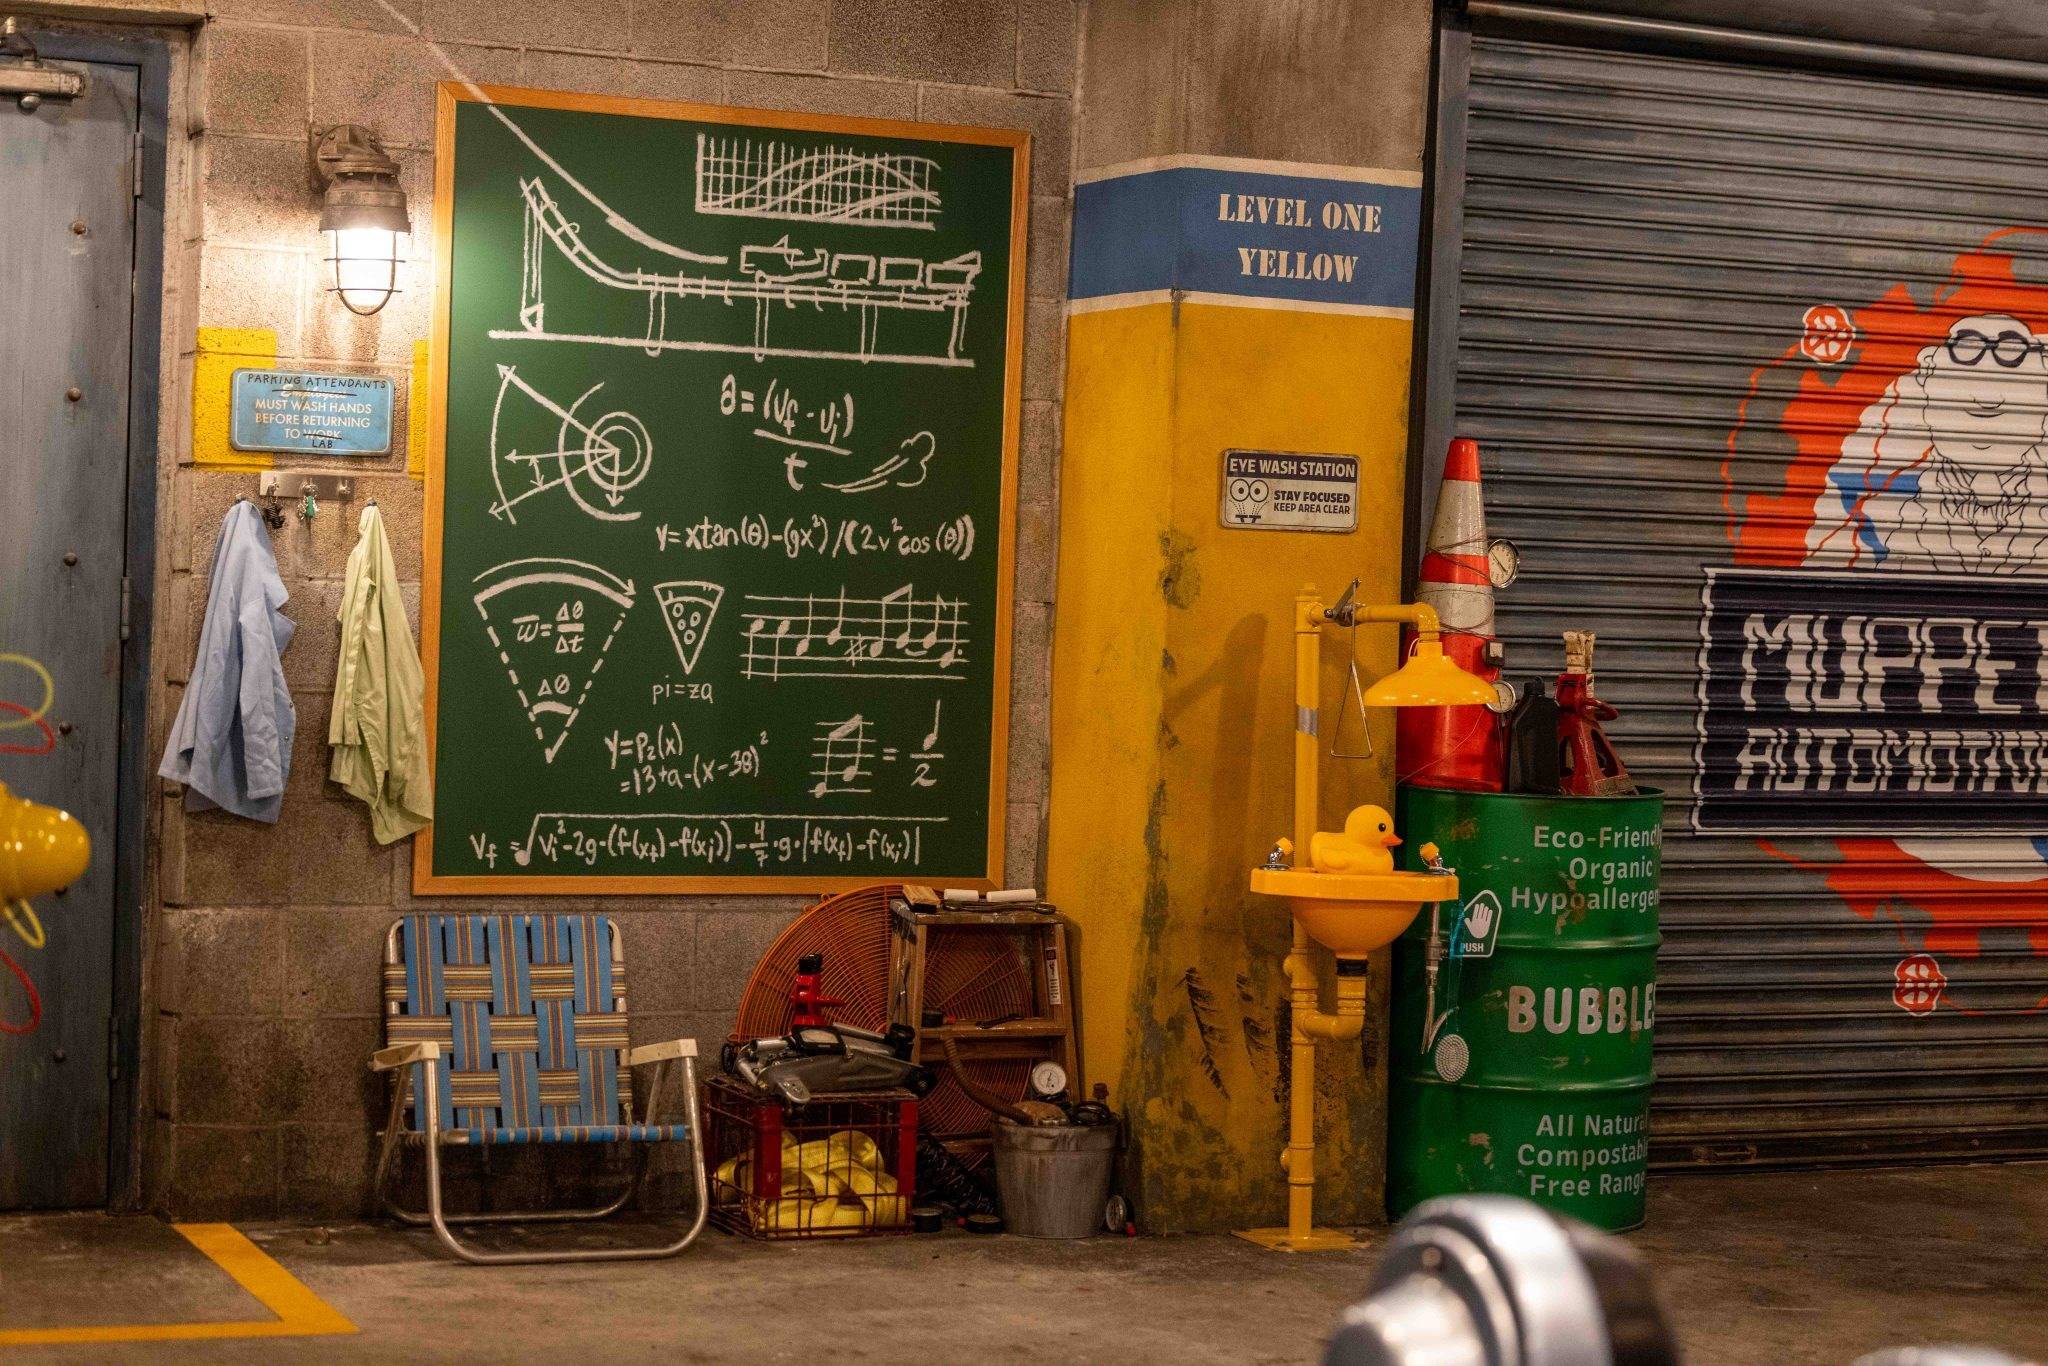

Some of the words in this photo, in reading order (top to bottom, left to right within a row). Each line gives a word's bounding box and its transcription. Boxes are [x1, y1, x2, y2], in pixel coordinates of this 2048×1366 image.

[1217, 193, 1312, 229] LEVEL
[1321, 201, 1382, 233] ONE
[1237, 247, 1359, 283] YELLOW
[248, 373, 301, 385] PARKING
[306, 377, 387, 389] ATTENDANTS
[255, 399, 288, 410] MUST
[291, 400, 327, 412] WASH
[329, 402, 372, 414] HANDS
[255, 412, 301, 425] BEFORE
[303, 414, 370, 428] RETURNING
[284, 428, 300, 439] TO
[303, 429, 341, 440] WORK
[312, 439, 333, 449] LAB
[1229, 458, 1256, 473] EYE
[1260, 459, 1297, 475] WASH
[1300, 461, 1356, 478] STATION
[1273, 490, 1301, 502] STAY
[1303, 491, 1351, 504] FOCUSED
[1273, 502, 1296, 513] KEEP
[1298, 504, 1321, 514] AREA
[1323, 504, 1351, 515] CLEAR
[1568, 856, 1653, 885] Organic
[1508, 982, 1657, 1035] BUBBLE
[1536, 1114, 1574, 1137] All
[1530, 1174, 1591, 1197] Free
[1600, 1170, 1646, 1196] Range
